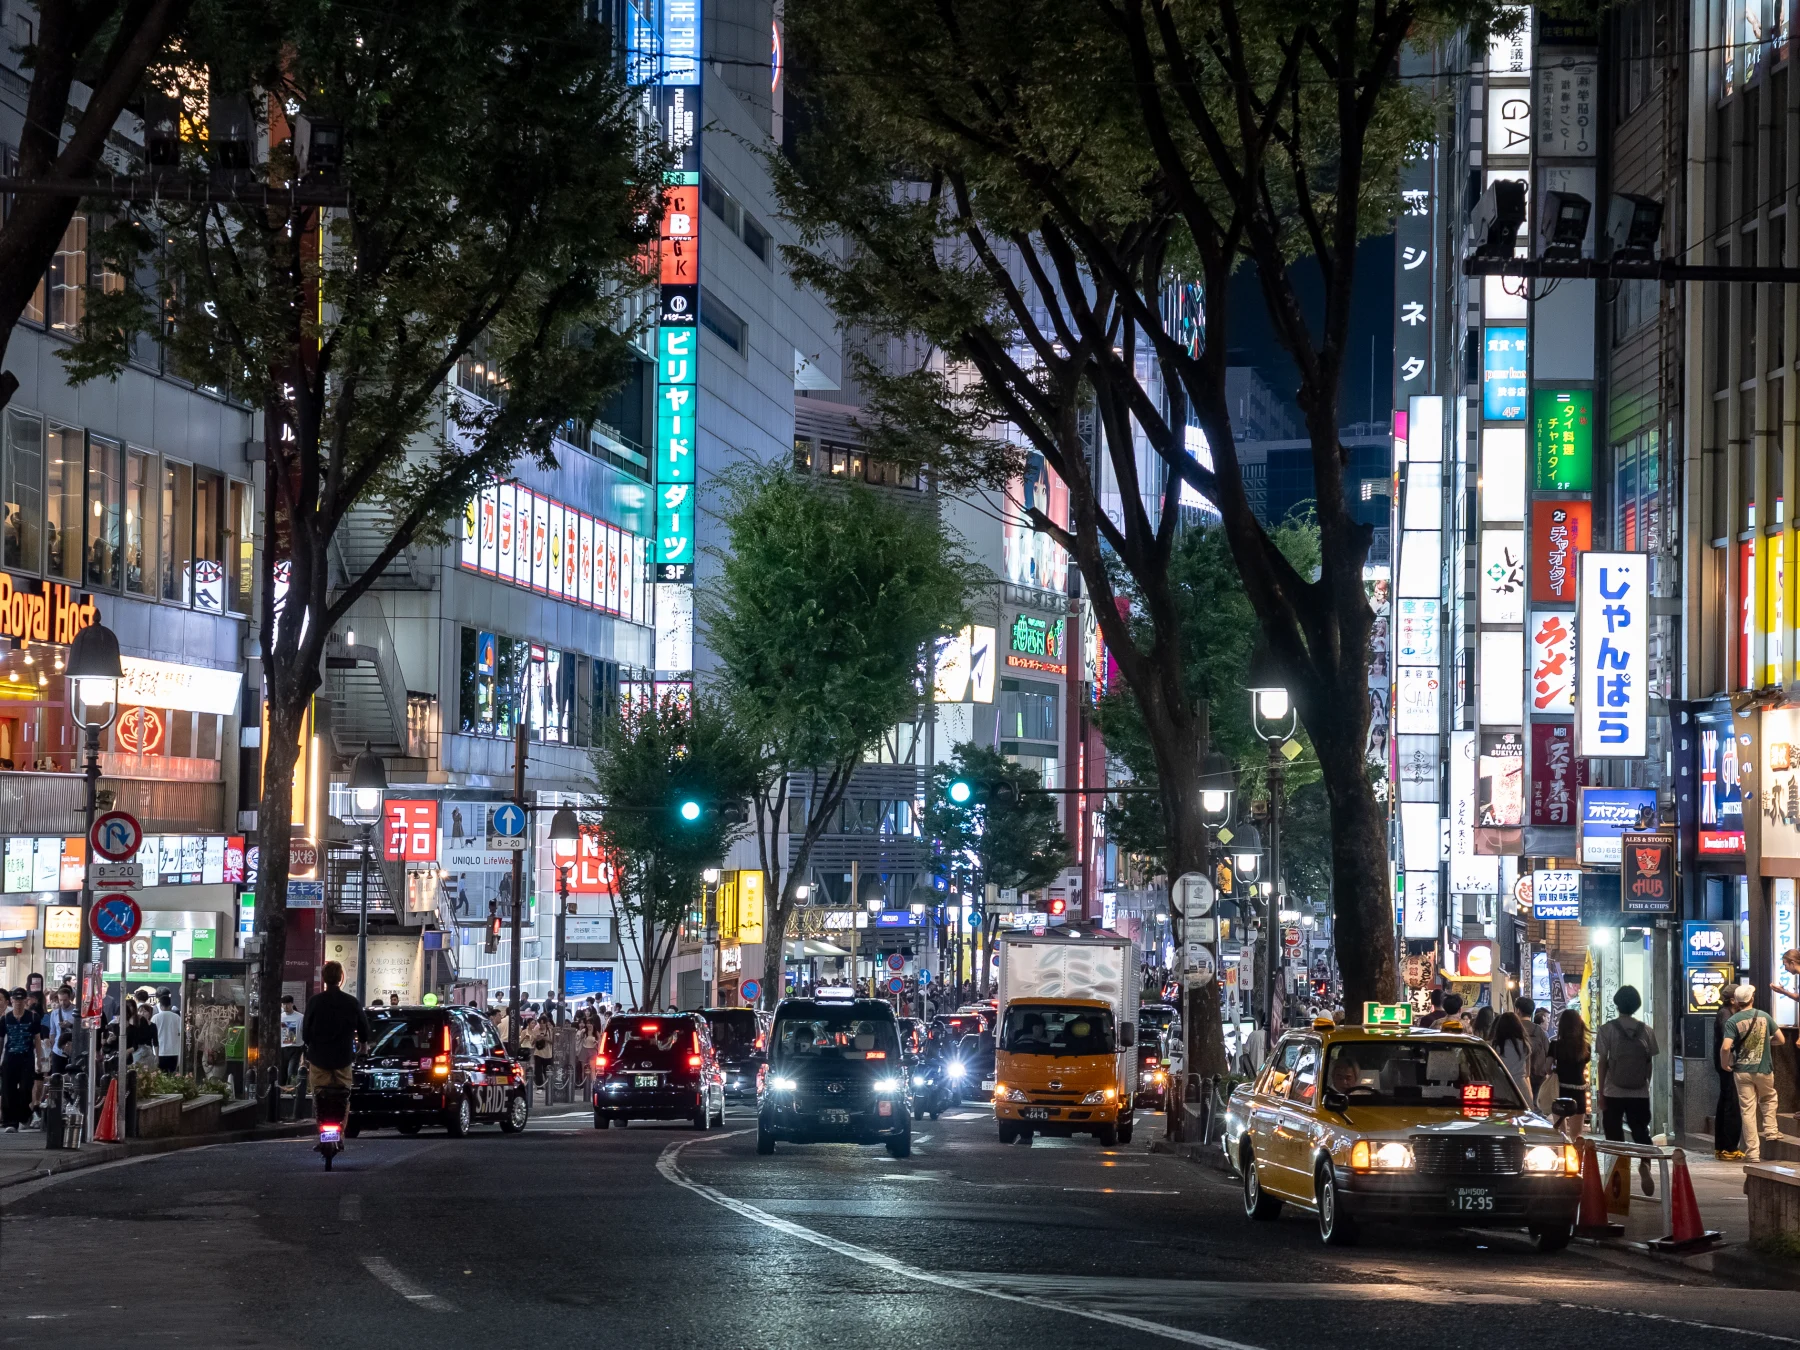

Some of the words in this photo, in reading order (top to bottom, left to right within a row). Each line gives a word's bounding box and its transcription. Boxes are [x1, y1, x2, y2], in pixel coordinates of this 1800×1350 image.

[669, 27, 695, 82] PRIME
[1502, 406, 1521, 418] 4F
[1562, 405, 1575, 456] タイ料理
[663, 331, 689, 560] ビリヤード・ダーツ
[1547, 417, 1559, 481] チャオタイ
[1557, 482, 1571, 490] 2F
[1553, 510, 1566, 522] 2F
[482, 497, 547, 568] カラオケ
[566, 517, 632, 602] まねきねこ
[1549, 525, 1569, 596] チャオタイ
[665, 566, 685, 580] 3F
[0, 572, 50, 650] Royal
[1533, 616, 1568, 710] ラーメン
[1596, 566, 1632, 744] じゃんぱら
[1404, 669, 1434, 679] 美容室
[389, 807, 430, 829] ユニ
[389, 833, 430, 855] クロ
[452, 856, 481, 866] UNIQLO
[483, 856, 516, 866] LifeWea
[1543, 872, 1573, 882] スマホ
[1538, 883, 1578, 892] パソコン
[1632, 878, 1664, 898] HUB
[1537, 892, 1579, 903] 買取販売
[1690, 930, 1725, 952] HUB
[369, 958, 411, 966] 人生の主役は
[371, 967, 408, 975] あなたです！
[1241, 950, 1249, 986] 道玄坂
[1373, 1006, 1407, 1022] 平和
[379, 1080, 399, 1088] 12-62
[1463, 1084, 1491, 1100] 空車
[475, 1085, 508, 1114] S.RIDE
[1029, 1111, 1049, 1120] 64-43
[1458, 1196, 1494, 1210] 12-95
